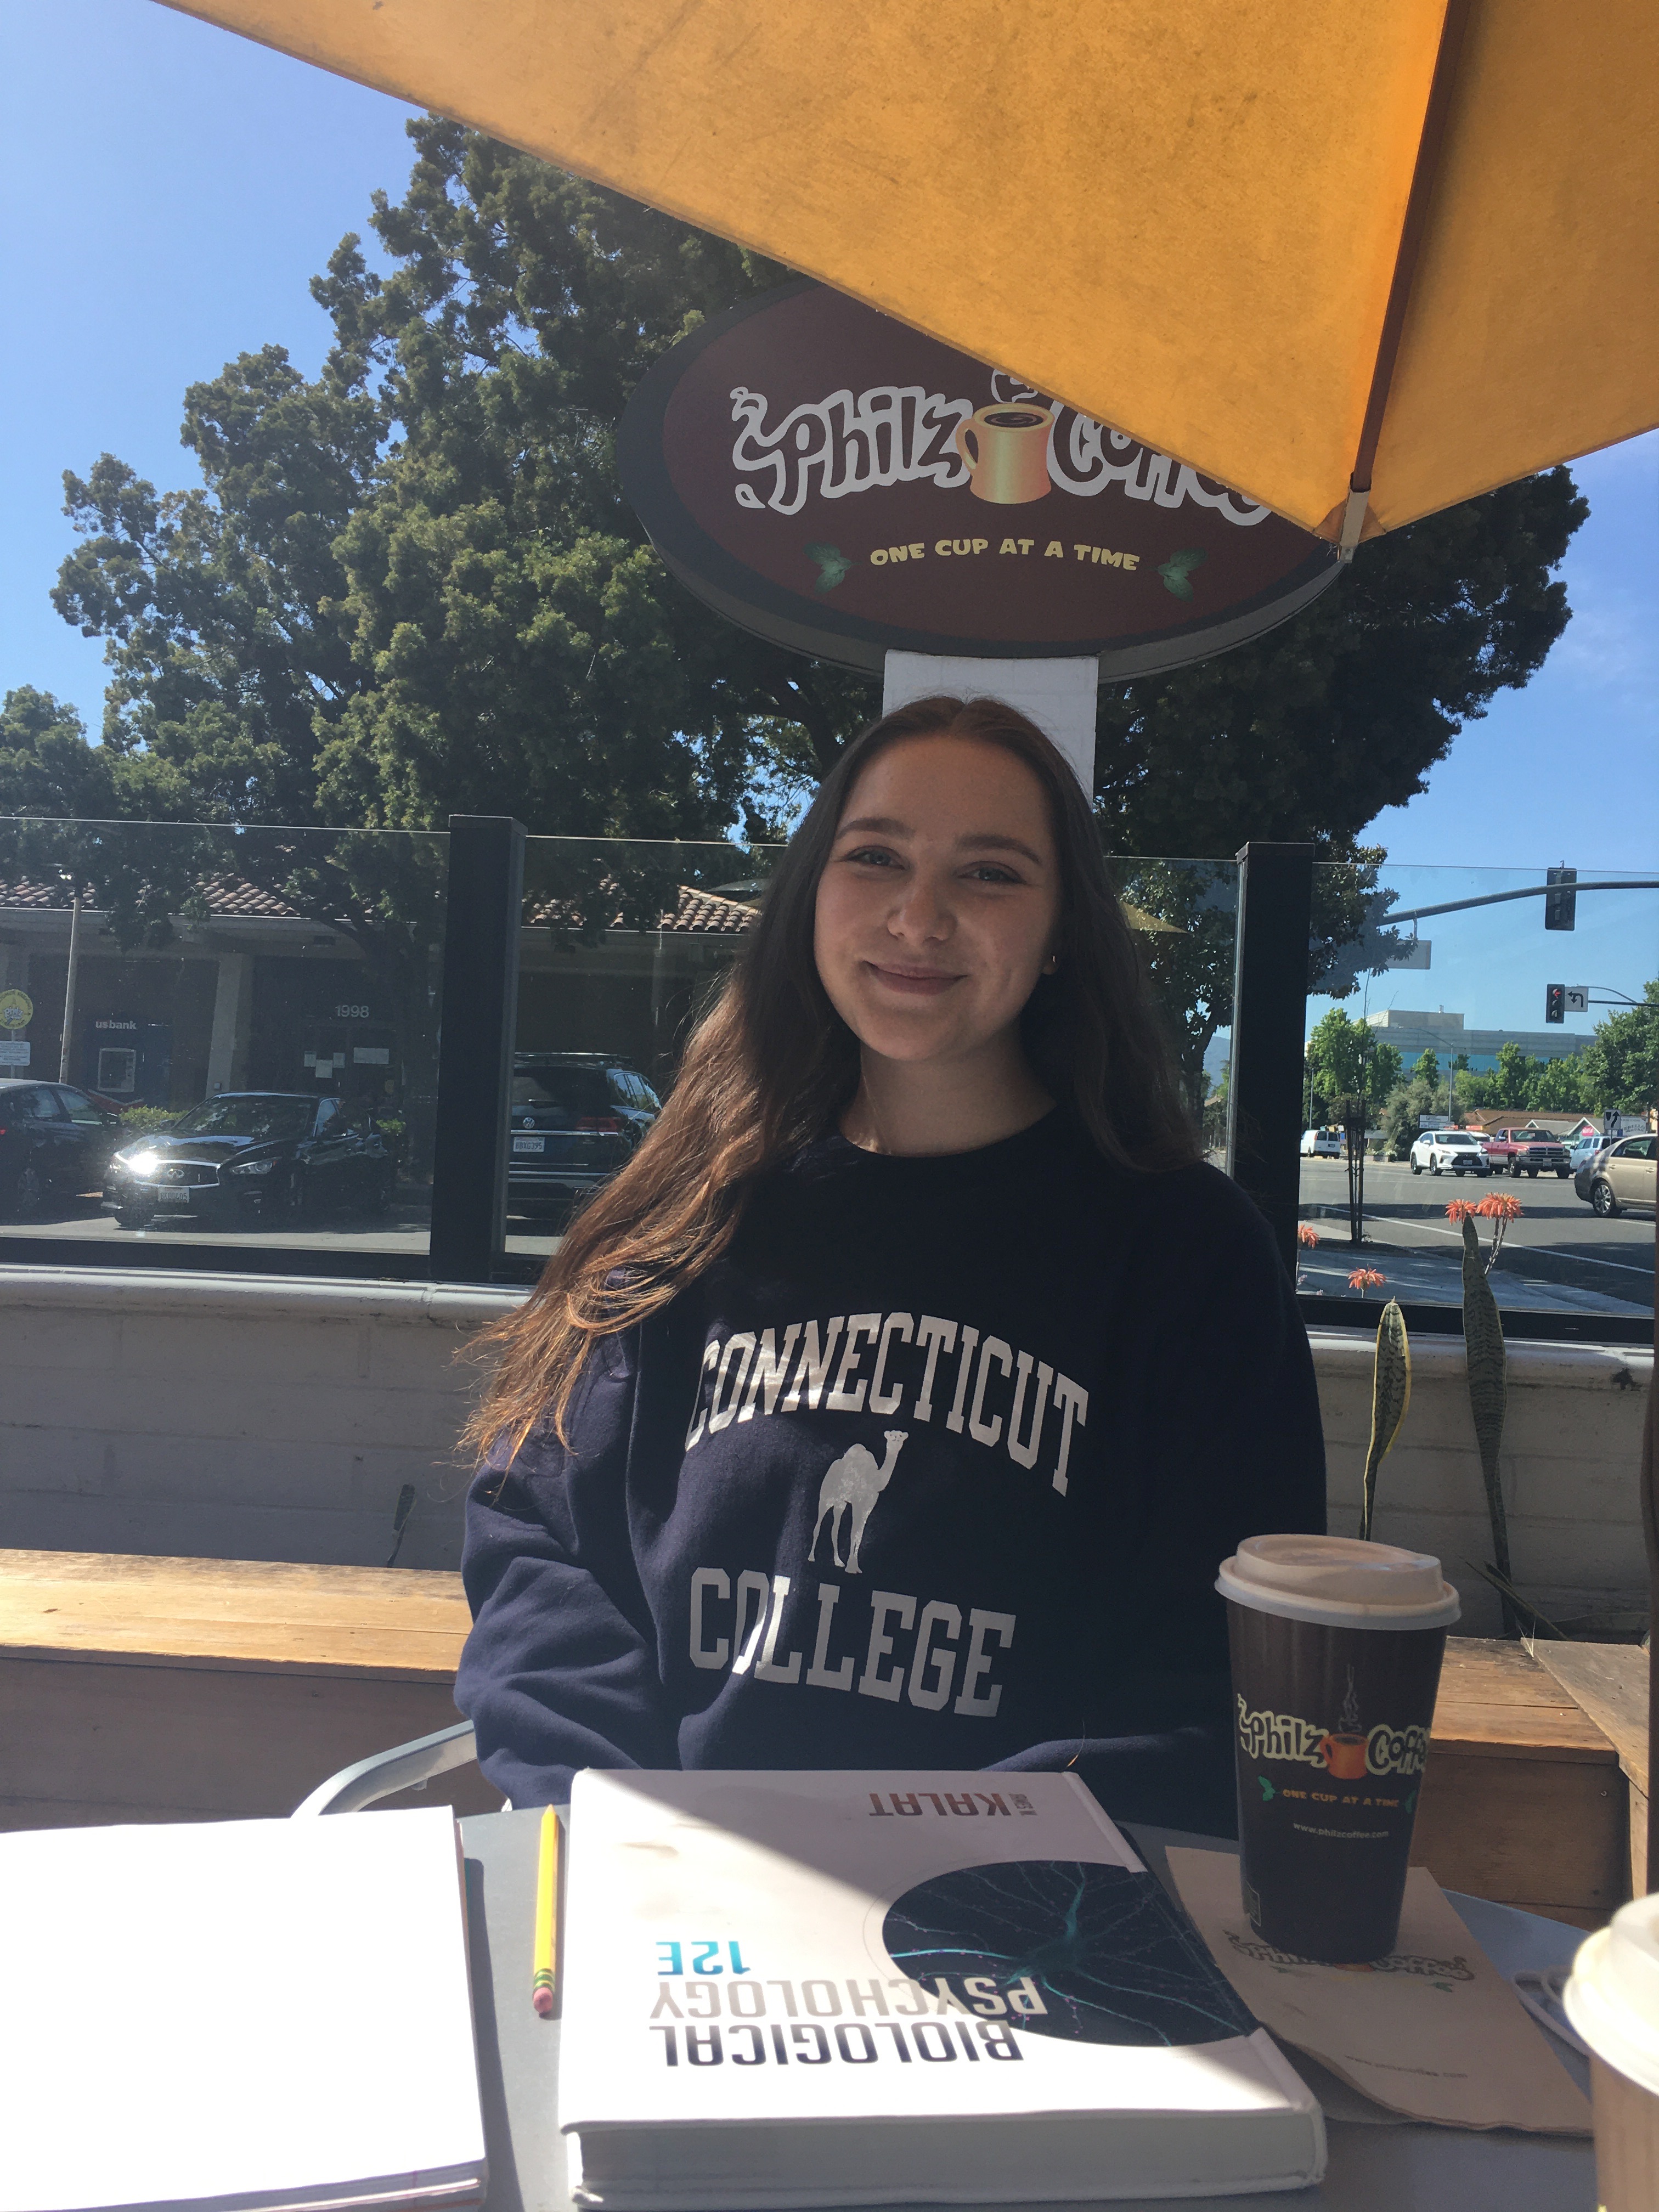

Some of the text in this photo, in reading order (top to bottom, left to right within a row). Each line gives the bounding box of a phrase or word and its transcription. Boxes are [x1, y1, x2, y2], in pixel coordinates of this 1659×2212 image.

[870, 538, 1141, 571] ONE CUP AT A TIME
[335, 1005, 369, 1018] 1998
[685, 1312, 1089, 1497] CONNECTICUT
[690, 1567, 1016, 1717] COLLEGE
[1238, 1693, 1429, 1775] Philz Coff
[869, 1793, 1011, 1816] KALAT
[1282, 1789, 1399, 1807] ONE CUP AT A TIME
[656, 1941, 751, 1975] 12E
[650, 1977, 1048, 2019] PSYCHOLOGY
[649, 2019, 1024, 2067] BIOLOGICAL
